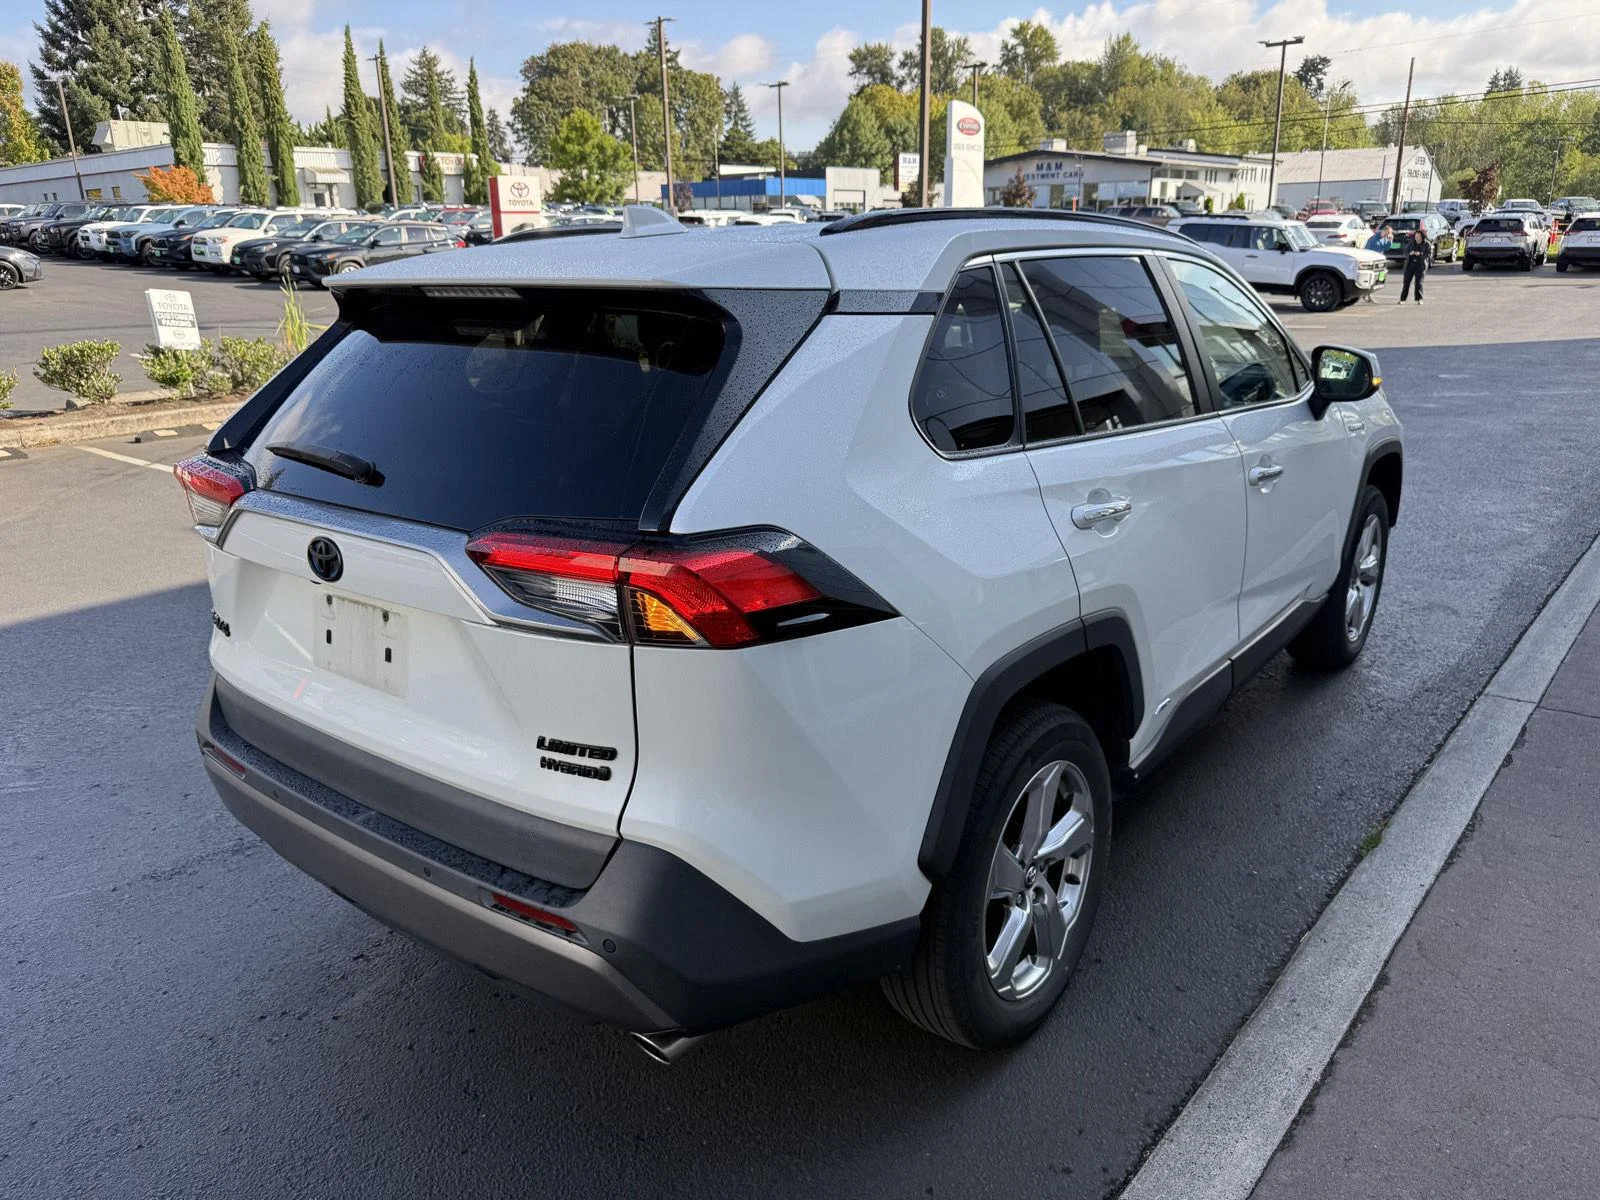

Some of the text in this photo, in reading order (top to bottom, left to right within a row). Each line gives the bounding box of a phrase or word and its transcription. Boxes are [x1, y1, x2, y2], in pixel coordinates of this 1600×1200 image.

[507, 199, 534, 207] TOYOTA
[157, 302, 189, 311] TOYOTA
[536, 735, 618, 761] LIMITED
[540, 756, 599, 780] HYBRID
